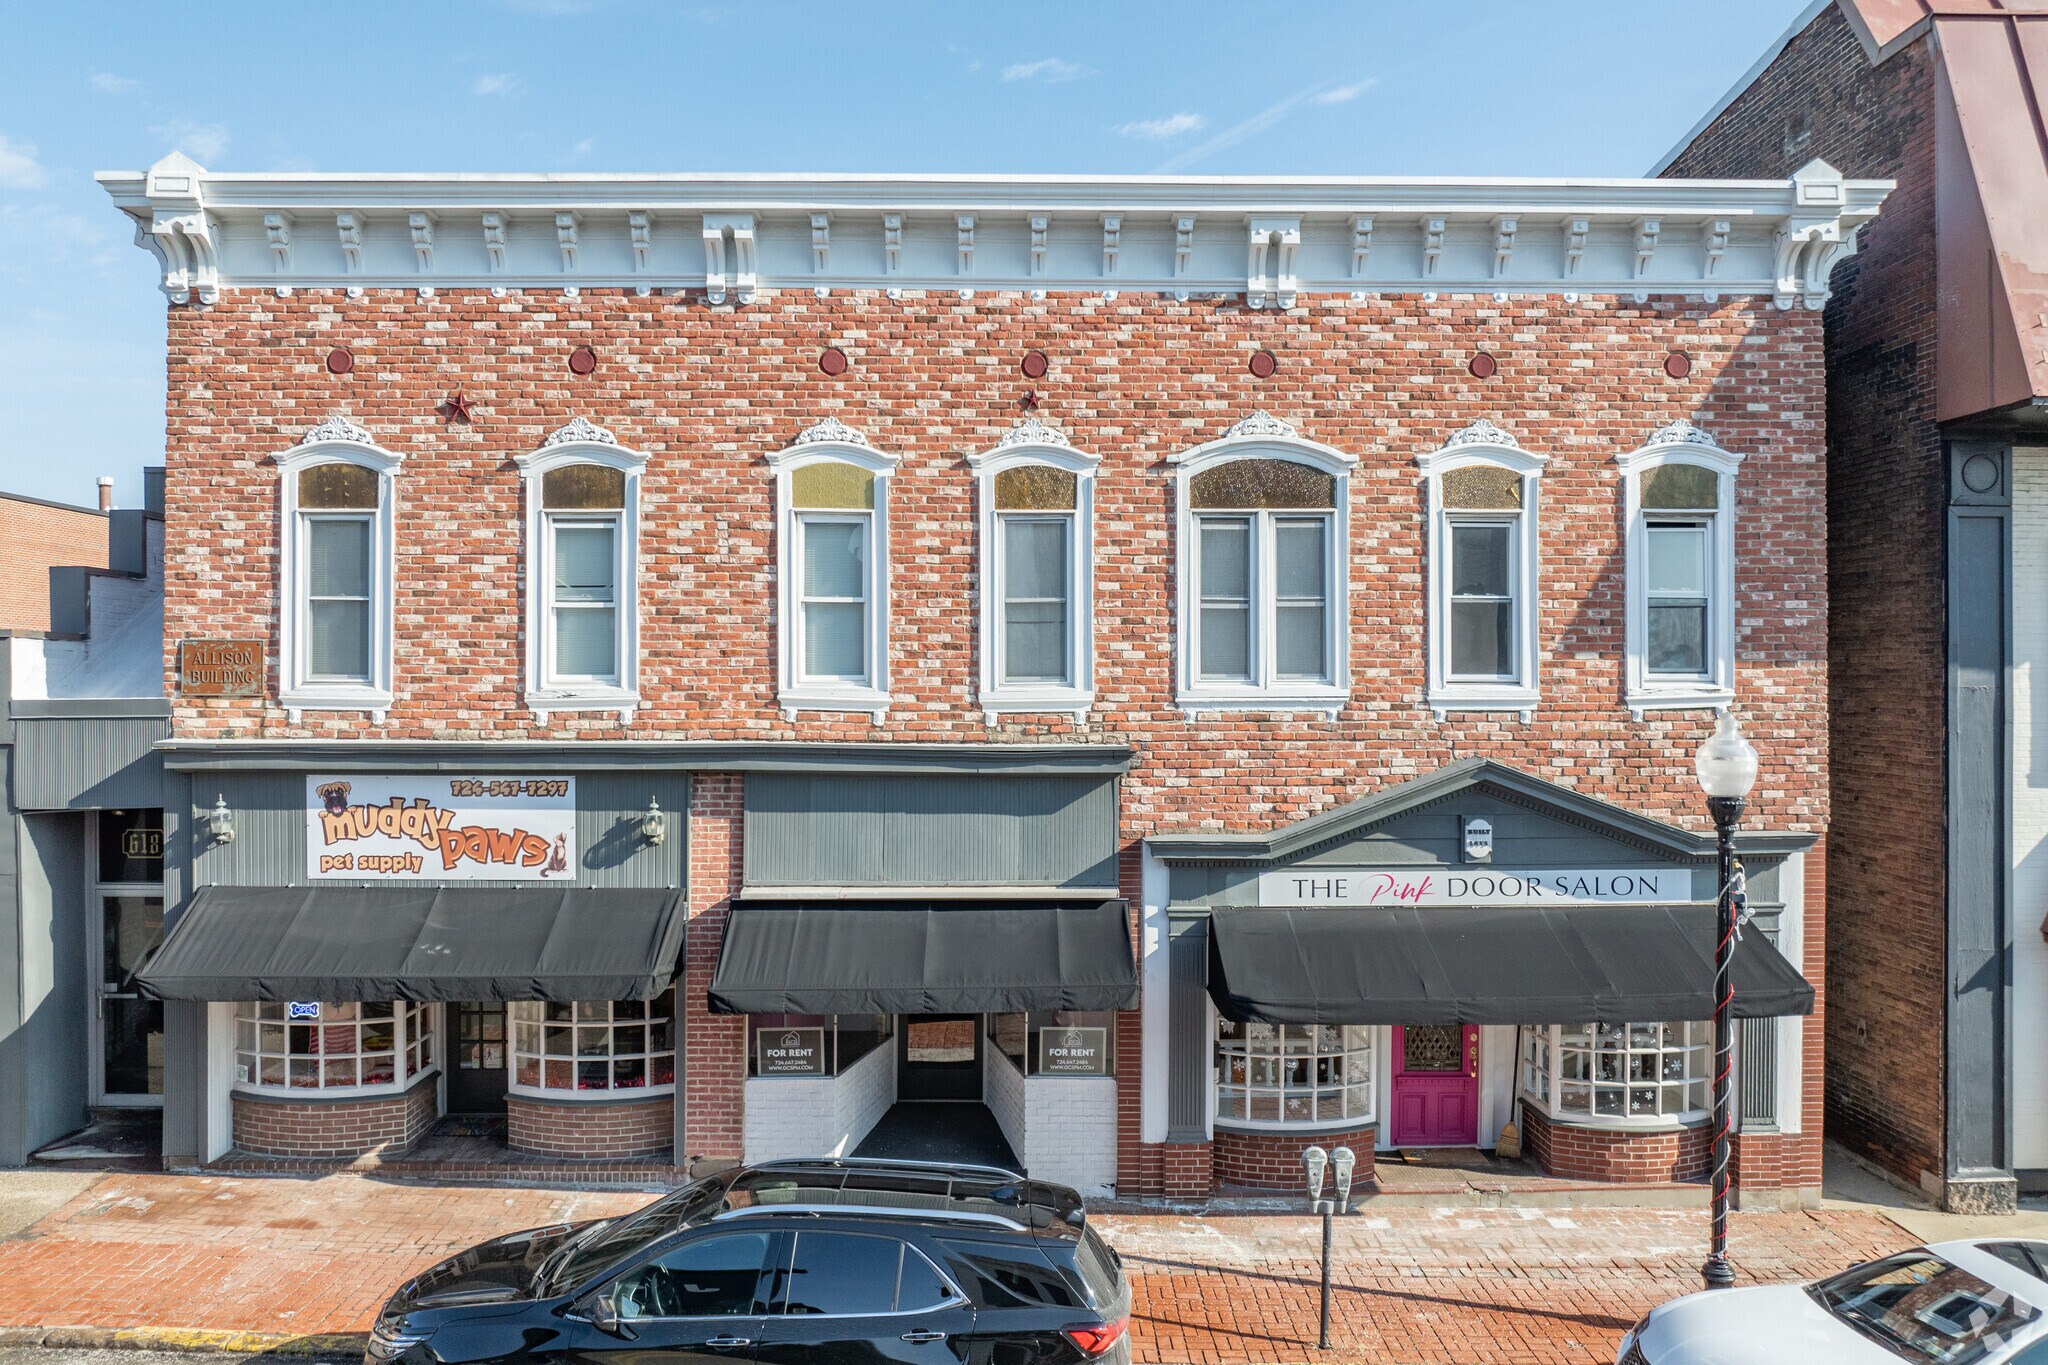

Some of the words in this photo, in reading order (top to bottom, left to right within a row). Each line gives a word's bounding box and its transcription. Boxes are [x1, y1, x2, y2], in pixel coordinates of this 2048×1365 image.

[192, 651, 253, 666] ALLISON
[190, 670, 253, 684] BUILDING
[450, 779, 569, 797] 724-547-7297
[322, 796, 456, 851] muddy
[129, 832, 160, 855] 618
[438, 825, 551, 870] paws
[320, 852, 354, 873] pet
[358, 851, 424, 874] supply
[1292, 878, 1348, 898] THE
[1357, 873, 1436, 904] Pink
[1447, 876, 1542, 898] DOOR
[1555, 875, 1659, 897] SALON
[294, 1006, 316, 1014] OPEN
[767, 1049, 786, 1057] FOR
[789, 1048, 813, 1057] RENT
[1049, 1048, 1068, 1057] FOR
[1071, 1048, 1094, 1057] RENT
